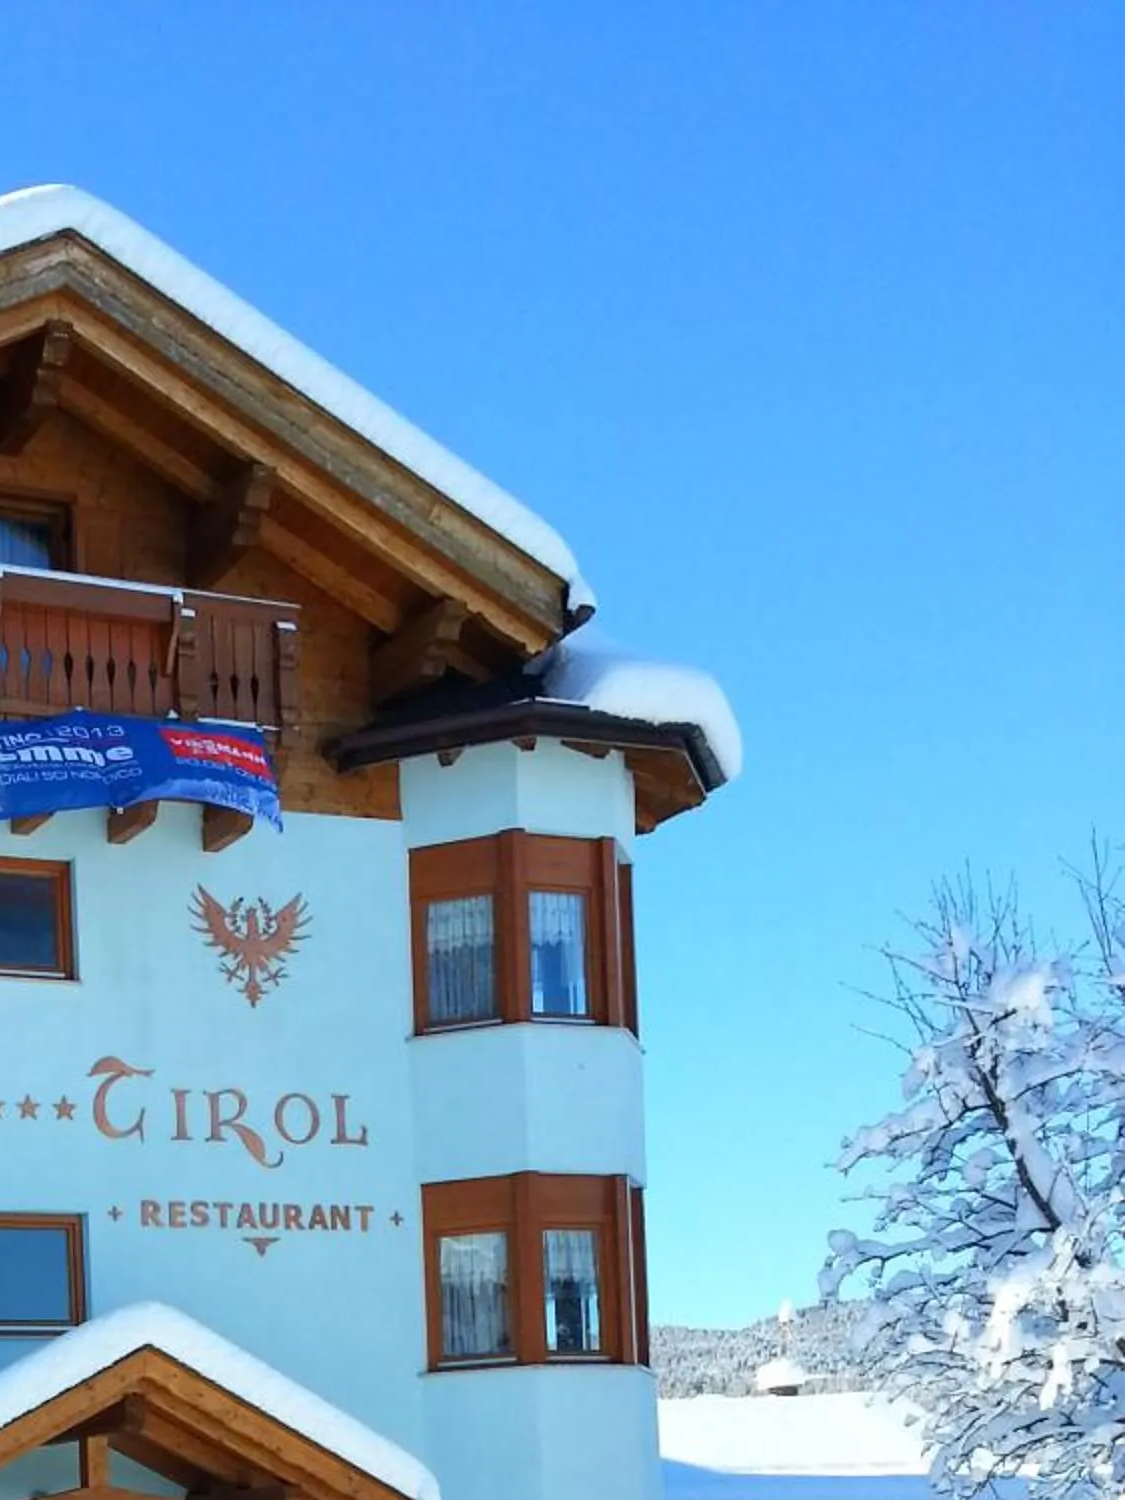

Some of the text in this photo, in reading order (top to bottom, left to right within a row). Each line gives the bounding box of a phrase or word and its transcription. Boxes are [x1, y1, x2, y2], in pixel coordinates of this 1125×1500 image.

[57, 724, 125, 739] 2013
[88, 1055, 369, 1169] TIROL
[140, 1199, 375, 1233] RESTAURANT
